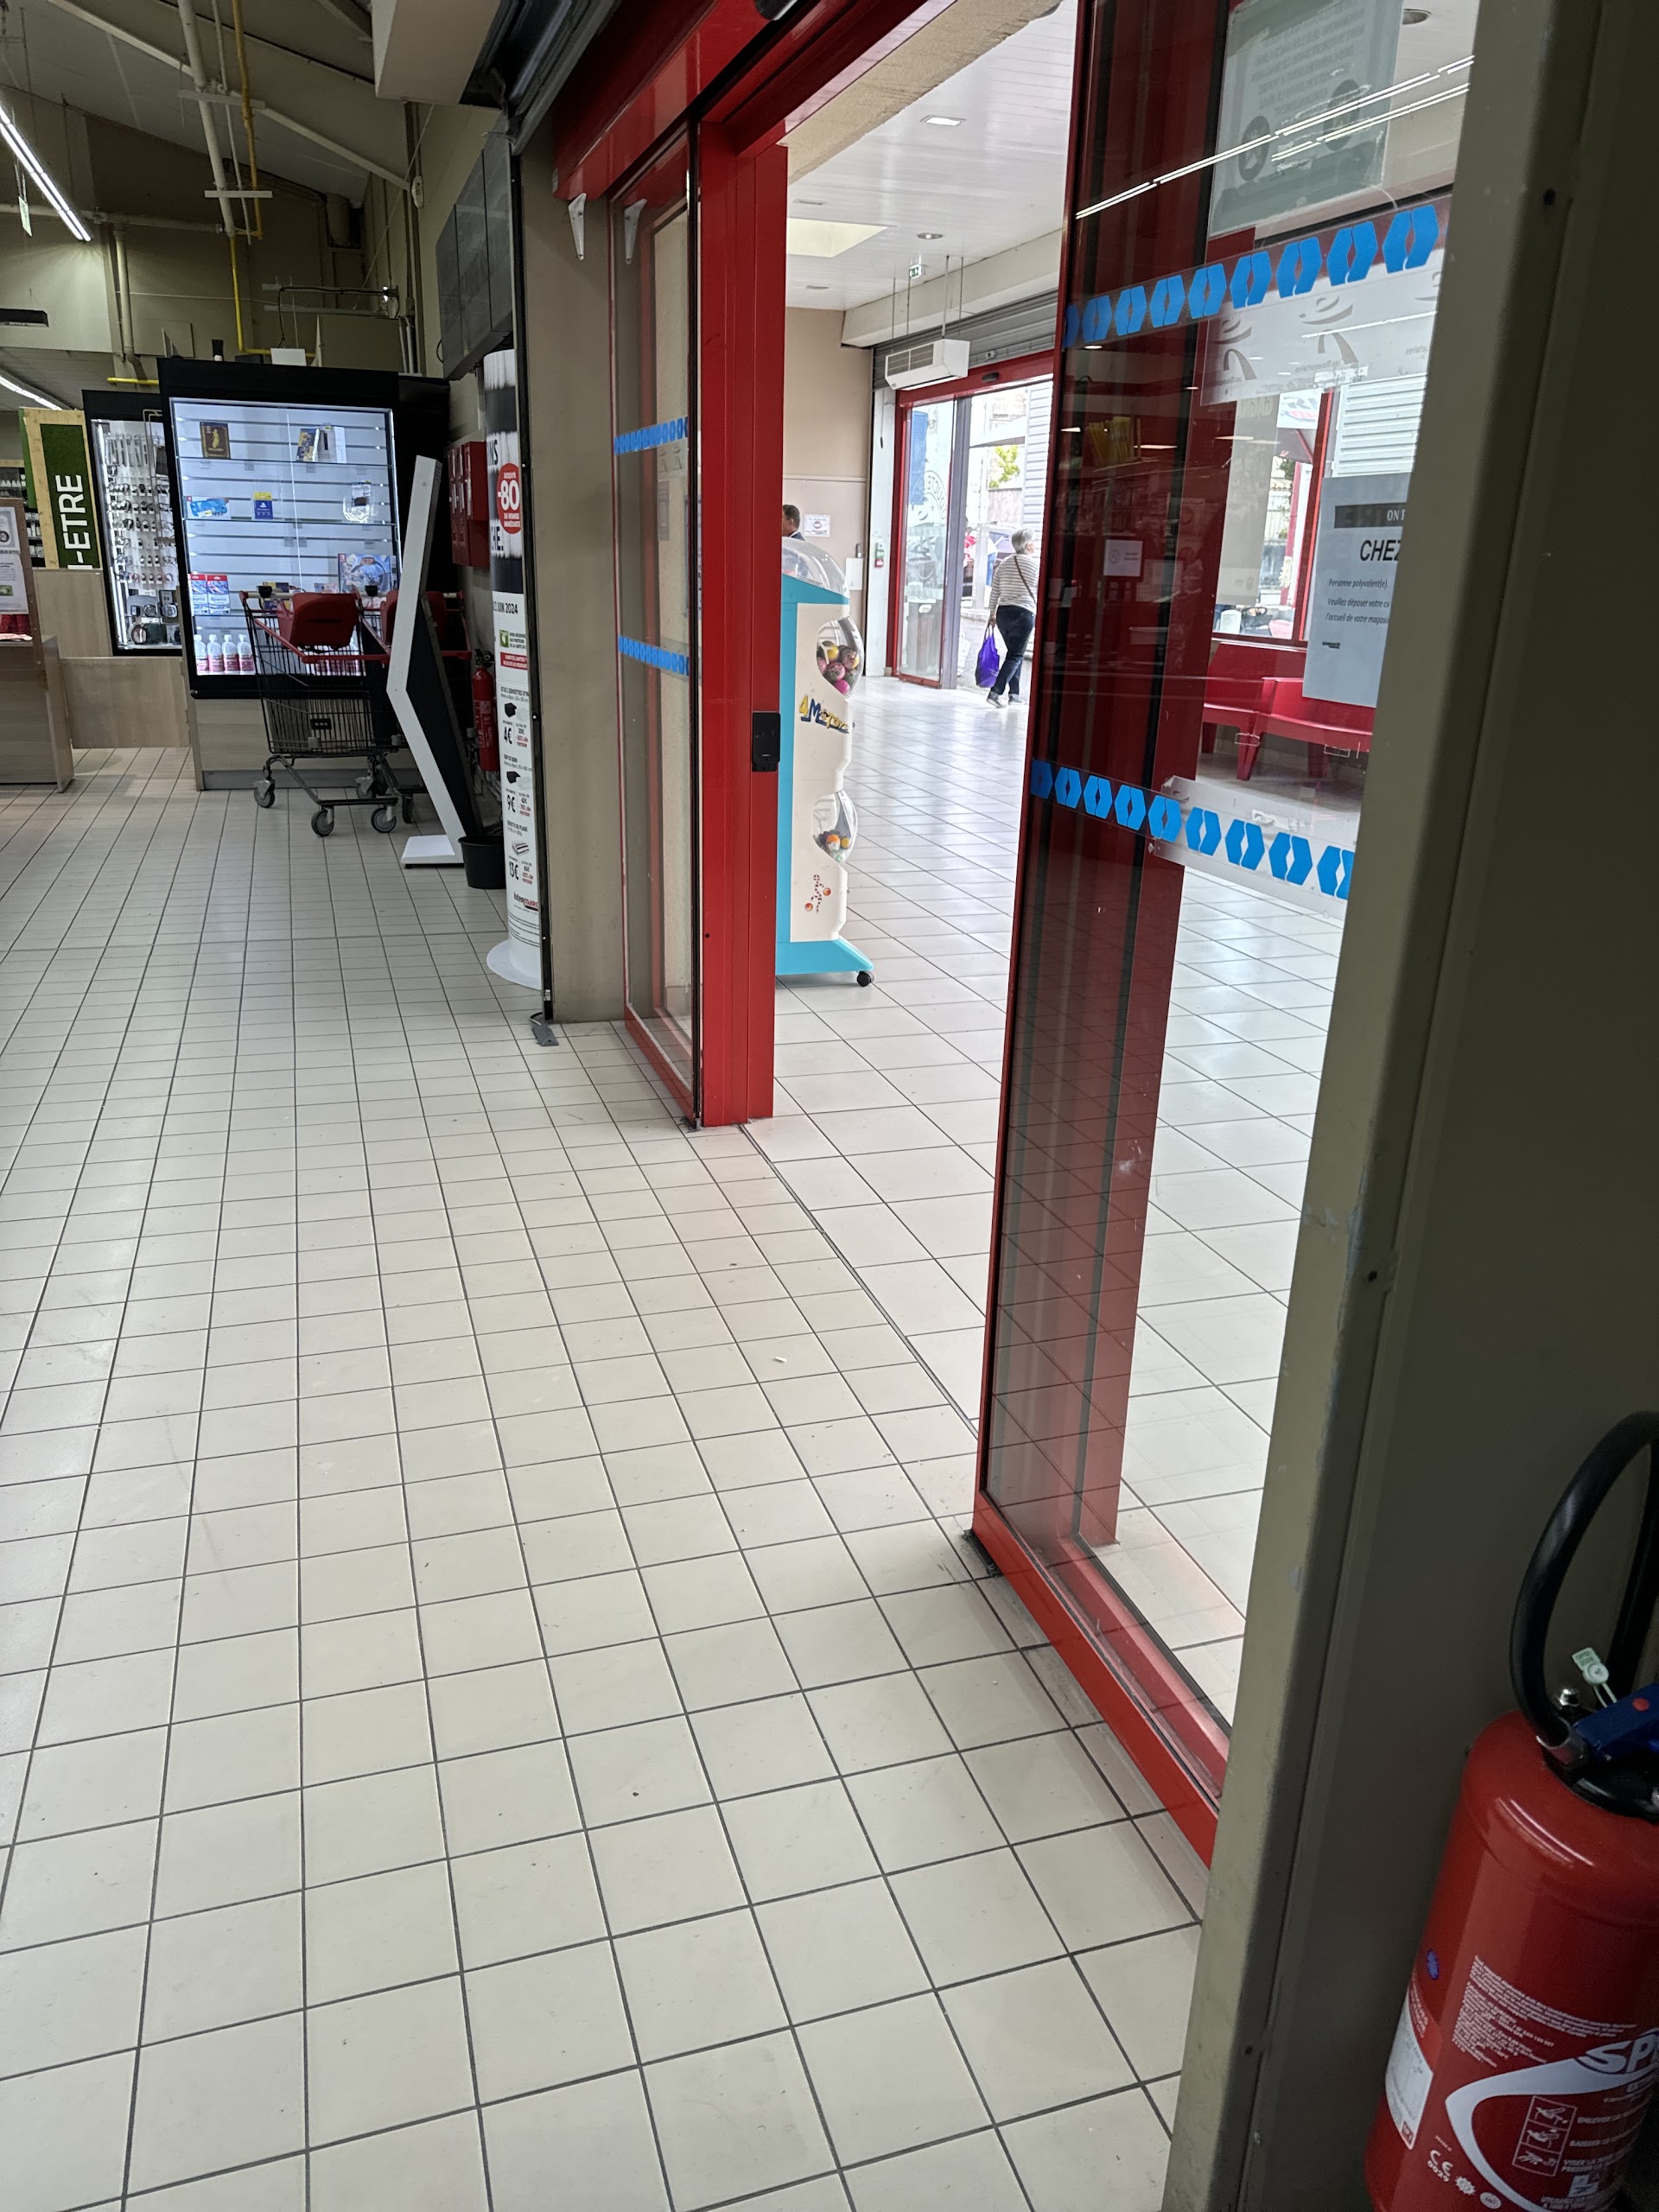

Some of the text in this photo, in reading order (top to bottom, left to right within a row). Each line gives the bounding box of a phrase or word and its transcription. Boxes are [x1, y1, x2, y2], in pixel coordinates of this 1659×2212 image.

[1387, 510, 1400, 521] ON
[1328, 578, 1352, 588] Personne
[1327, 597, 1347, 607] Veuillez
[1347, 598, 1369, 607] déposer
[1369, 599, 1383, 607] votre
[505, 603, 518, 615] 2024
[1353, 614, 1368, 623] votre
[1367, 616, 1389, 626] magasi
[1577, 2032, 1659, 2075] SP
